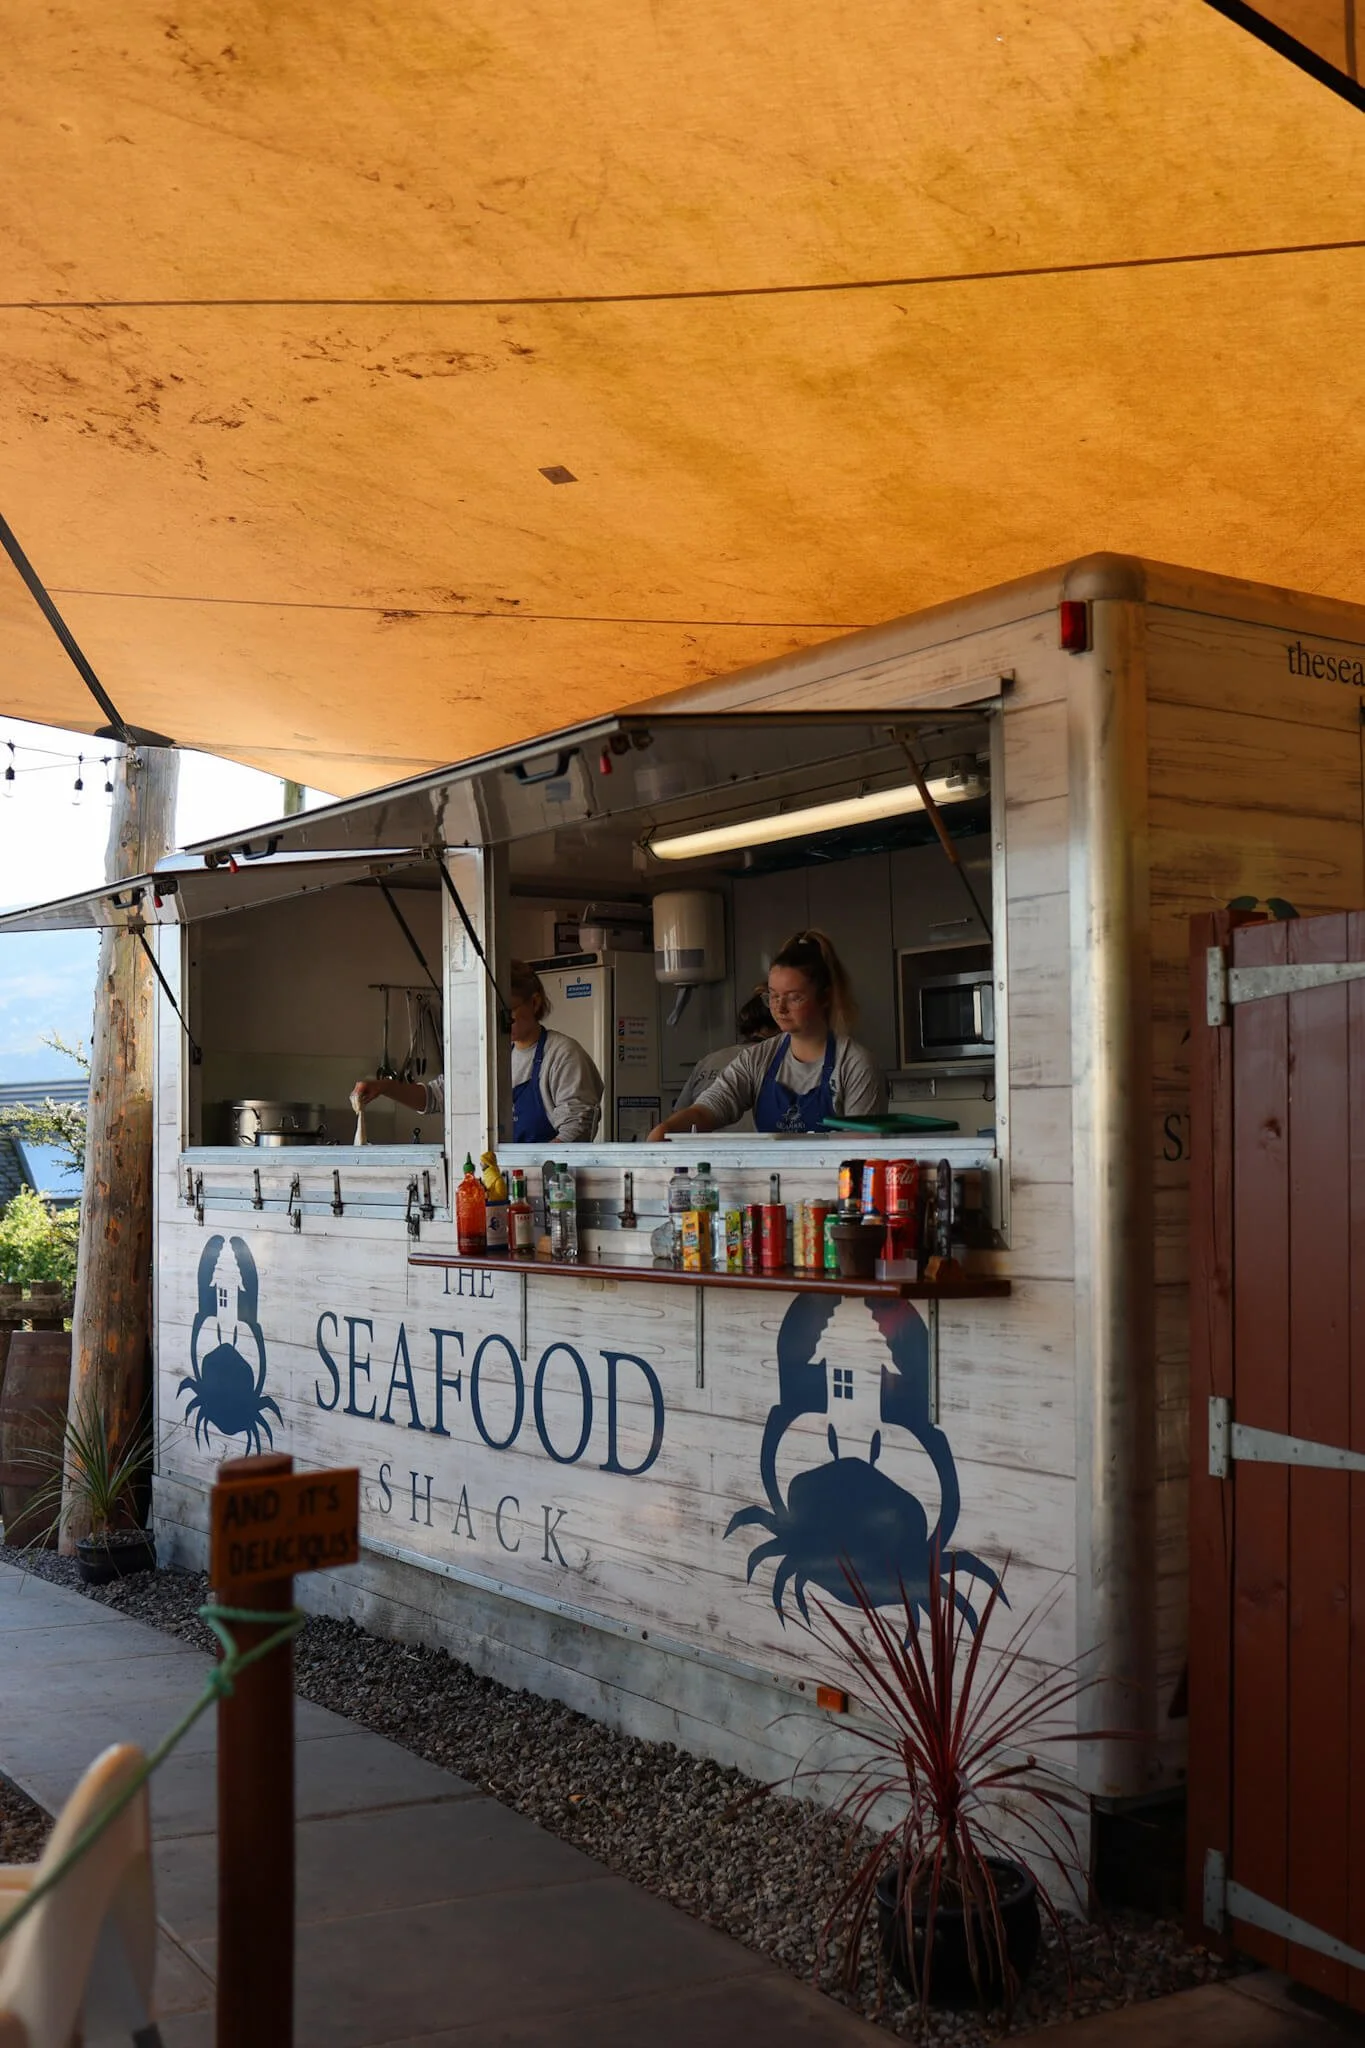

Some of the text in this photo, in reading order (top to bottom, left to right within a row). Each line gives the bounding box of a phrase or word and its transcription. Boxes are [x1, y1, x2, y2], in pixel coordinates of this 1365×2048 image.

[443, 1267, 495, 1299] THE
[315, 1311, 665, 1476] SEAFOOD
[222, 1488, 281, 1532] AND
[378, 1463, 569, 1567] SHACK
